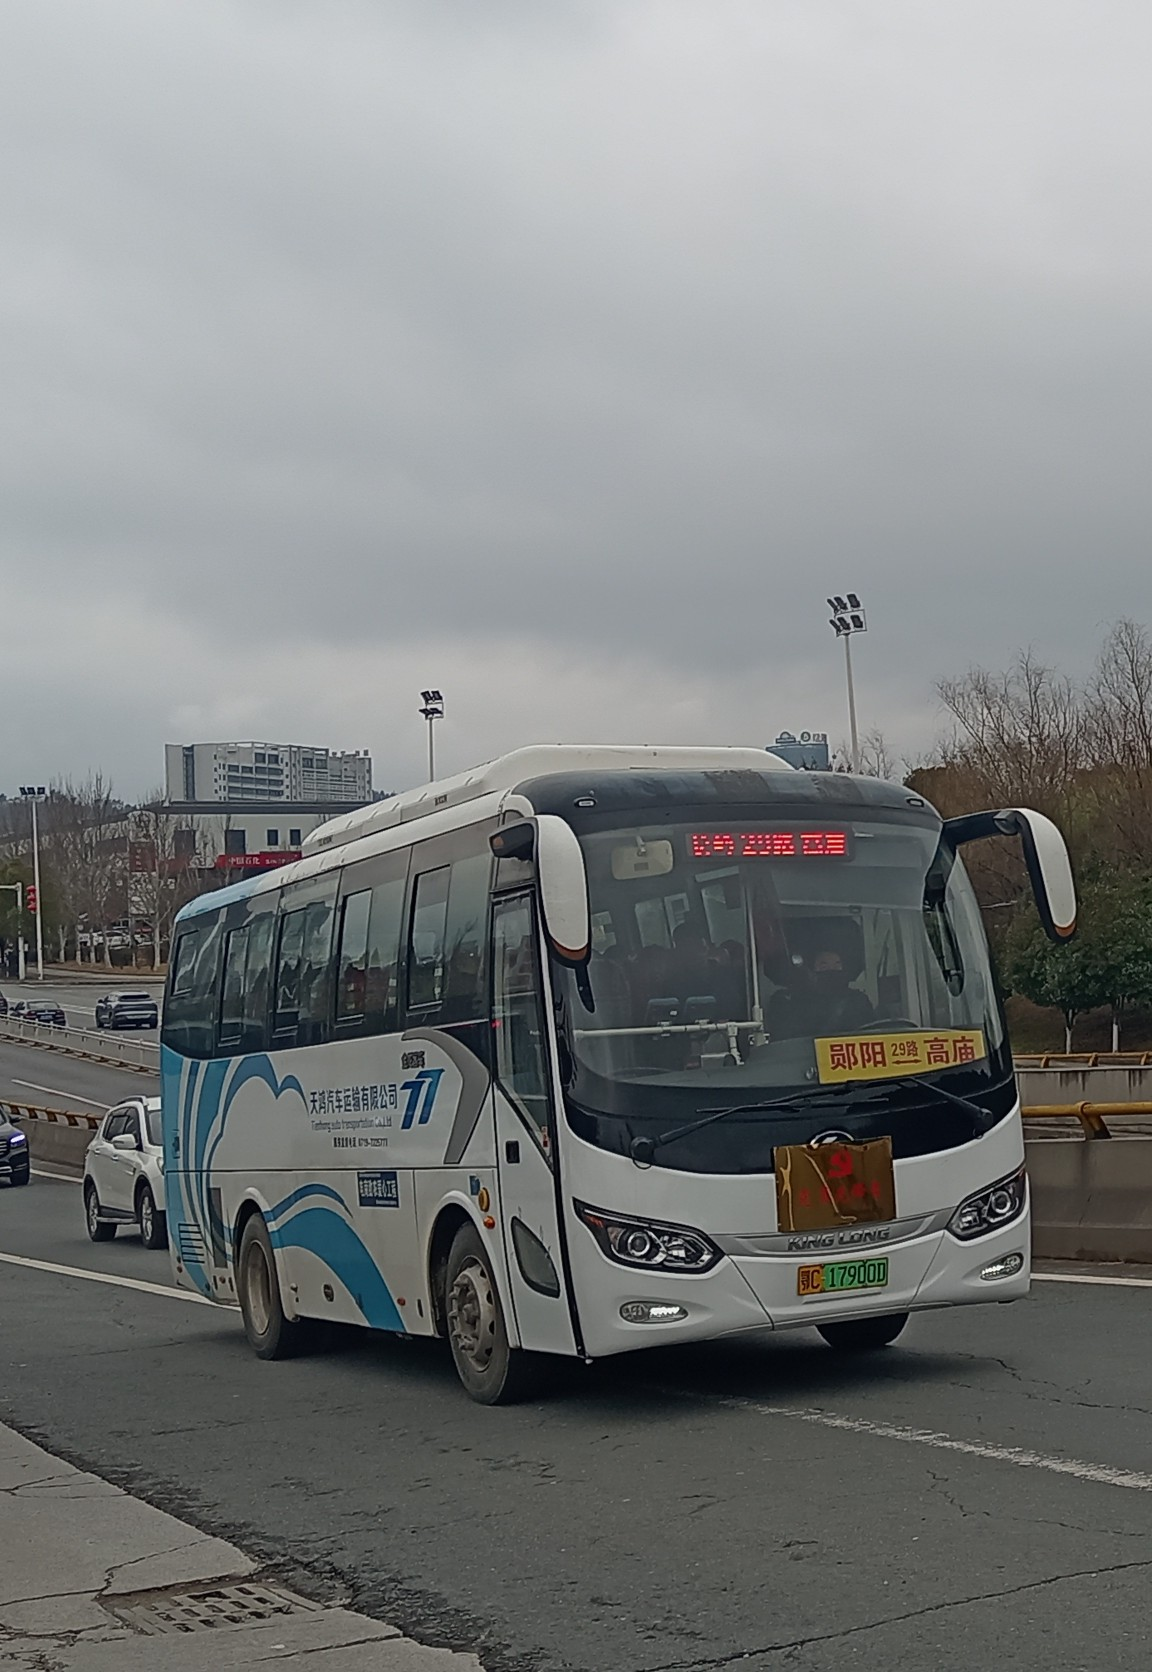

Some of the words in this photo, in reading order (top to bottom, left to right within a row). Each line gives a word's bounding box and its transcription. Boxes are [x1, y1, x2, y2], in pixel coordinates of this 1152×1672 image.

[830, 1041, 887, 1070] 郧阳
[891, 1040, 919, 1057] 29路
[923, 1036, 975, 1064] 高庙
[310, 1084, 398, 1115] 天鸿汽车运输有限公司
[788, 1233, 835, 1251] KING
[839, 1227, 890, 1245] LONG
